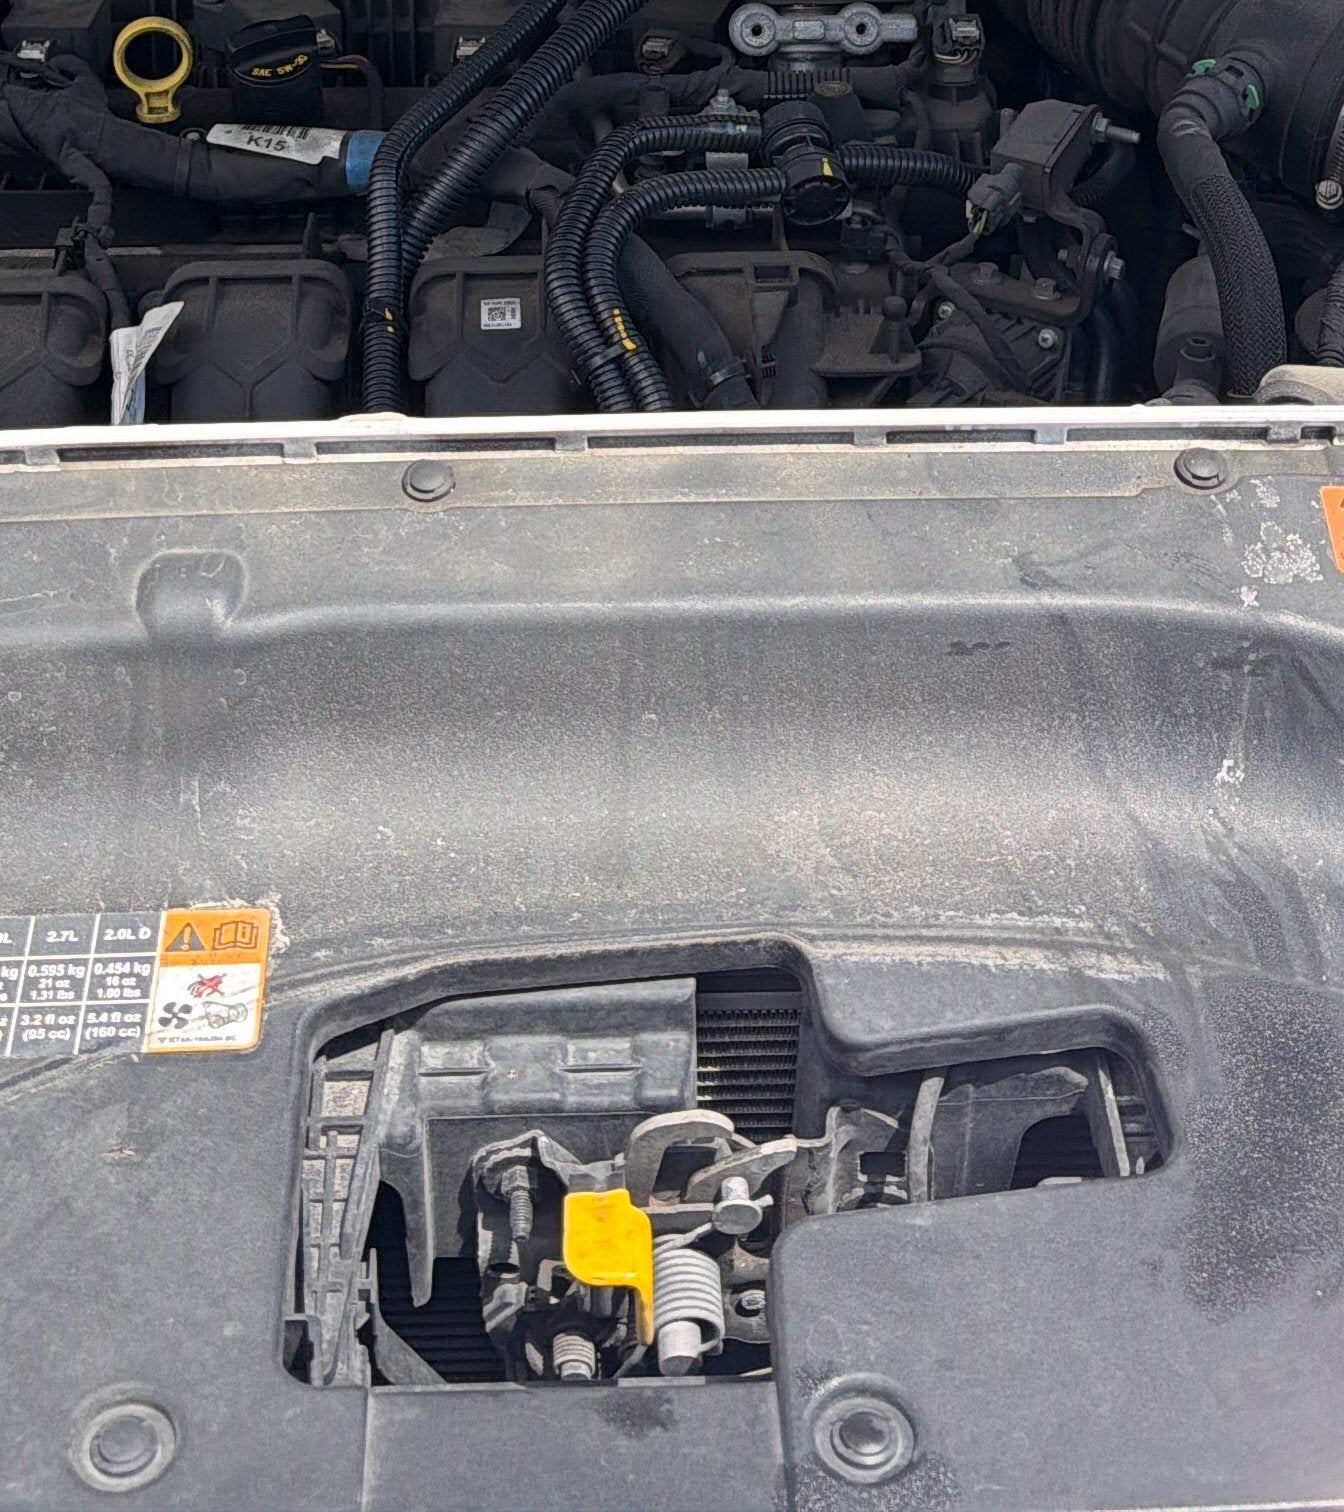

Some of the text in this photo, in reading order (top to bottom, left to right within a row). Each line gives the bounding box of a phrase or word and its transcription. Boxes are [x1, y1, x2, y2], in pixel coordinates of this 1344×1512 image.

[250, 66, 273, 77] SAE
[245, 134, 288, 151] K15
[45, 929, 78, 943] 2.7L
[103, 926, 151, 941] 2.0L D
[0, 965, 18, 980] kg
[27, 962, 86, 978] 0.595 kg
[93, 960, 150, 976] 0.454 kg
[37, 977, 70, 988] 21 oz
[105, 976, 136, 986] 16 oz
[30, 989, 74, 1000] 1.31 lbs
[96, 987, 141, 998] 1.00 lbs
[19, 1013, 75, 1025] 3.2 fl oz
[86, 1011, 141, 1023] 5.4 fl oz
[22, 1027, 70, 1041] (95 cc)
[85, 1025, 141, 1040] (160 cc)
